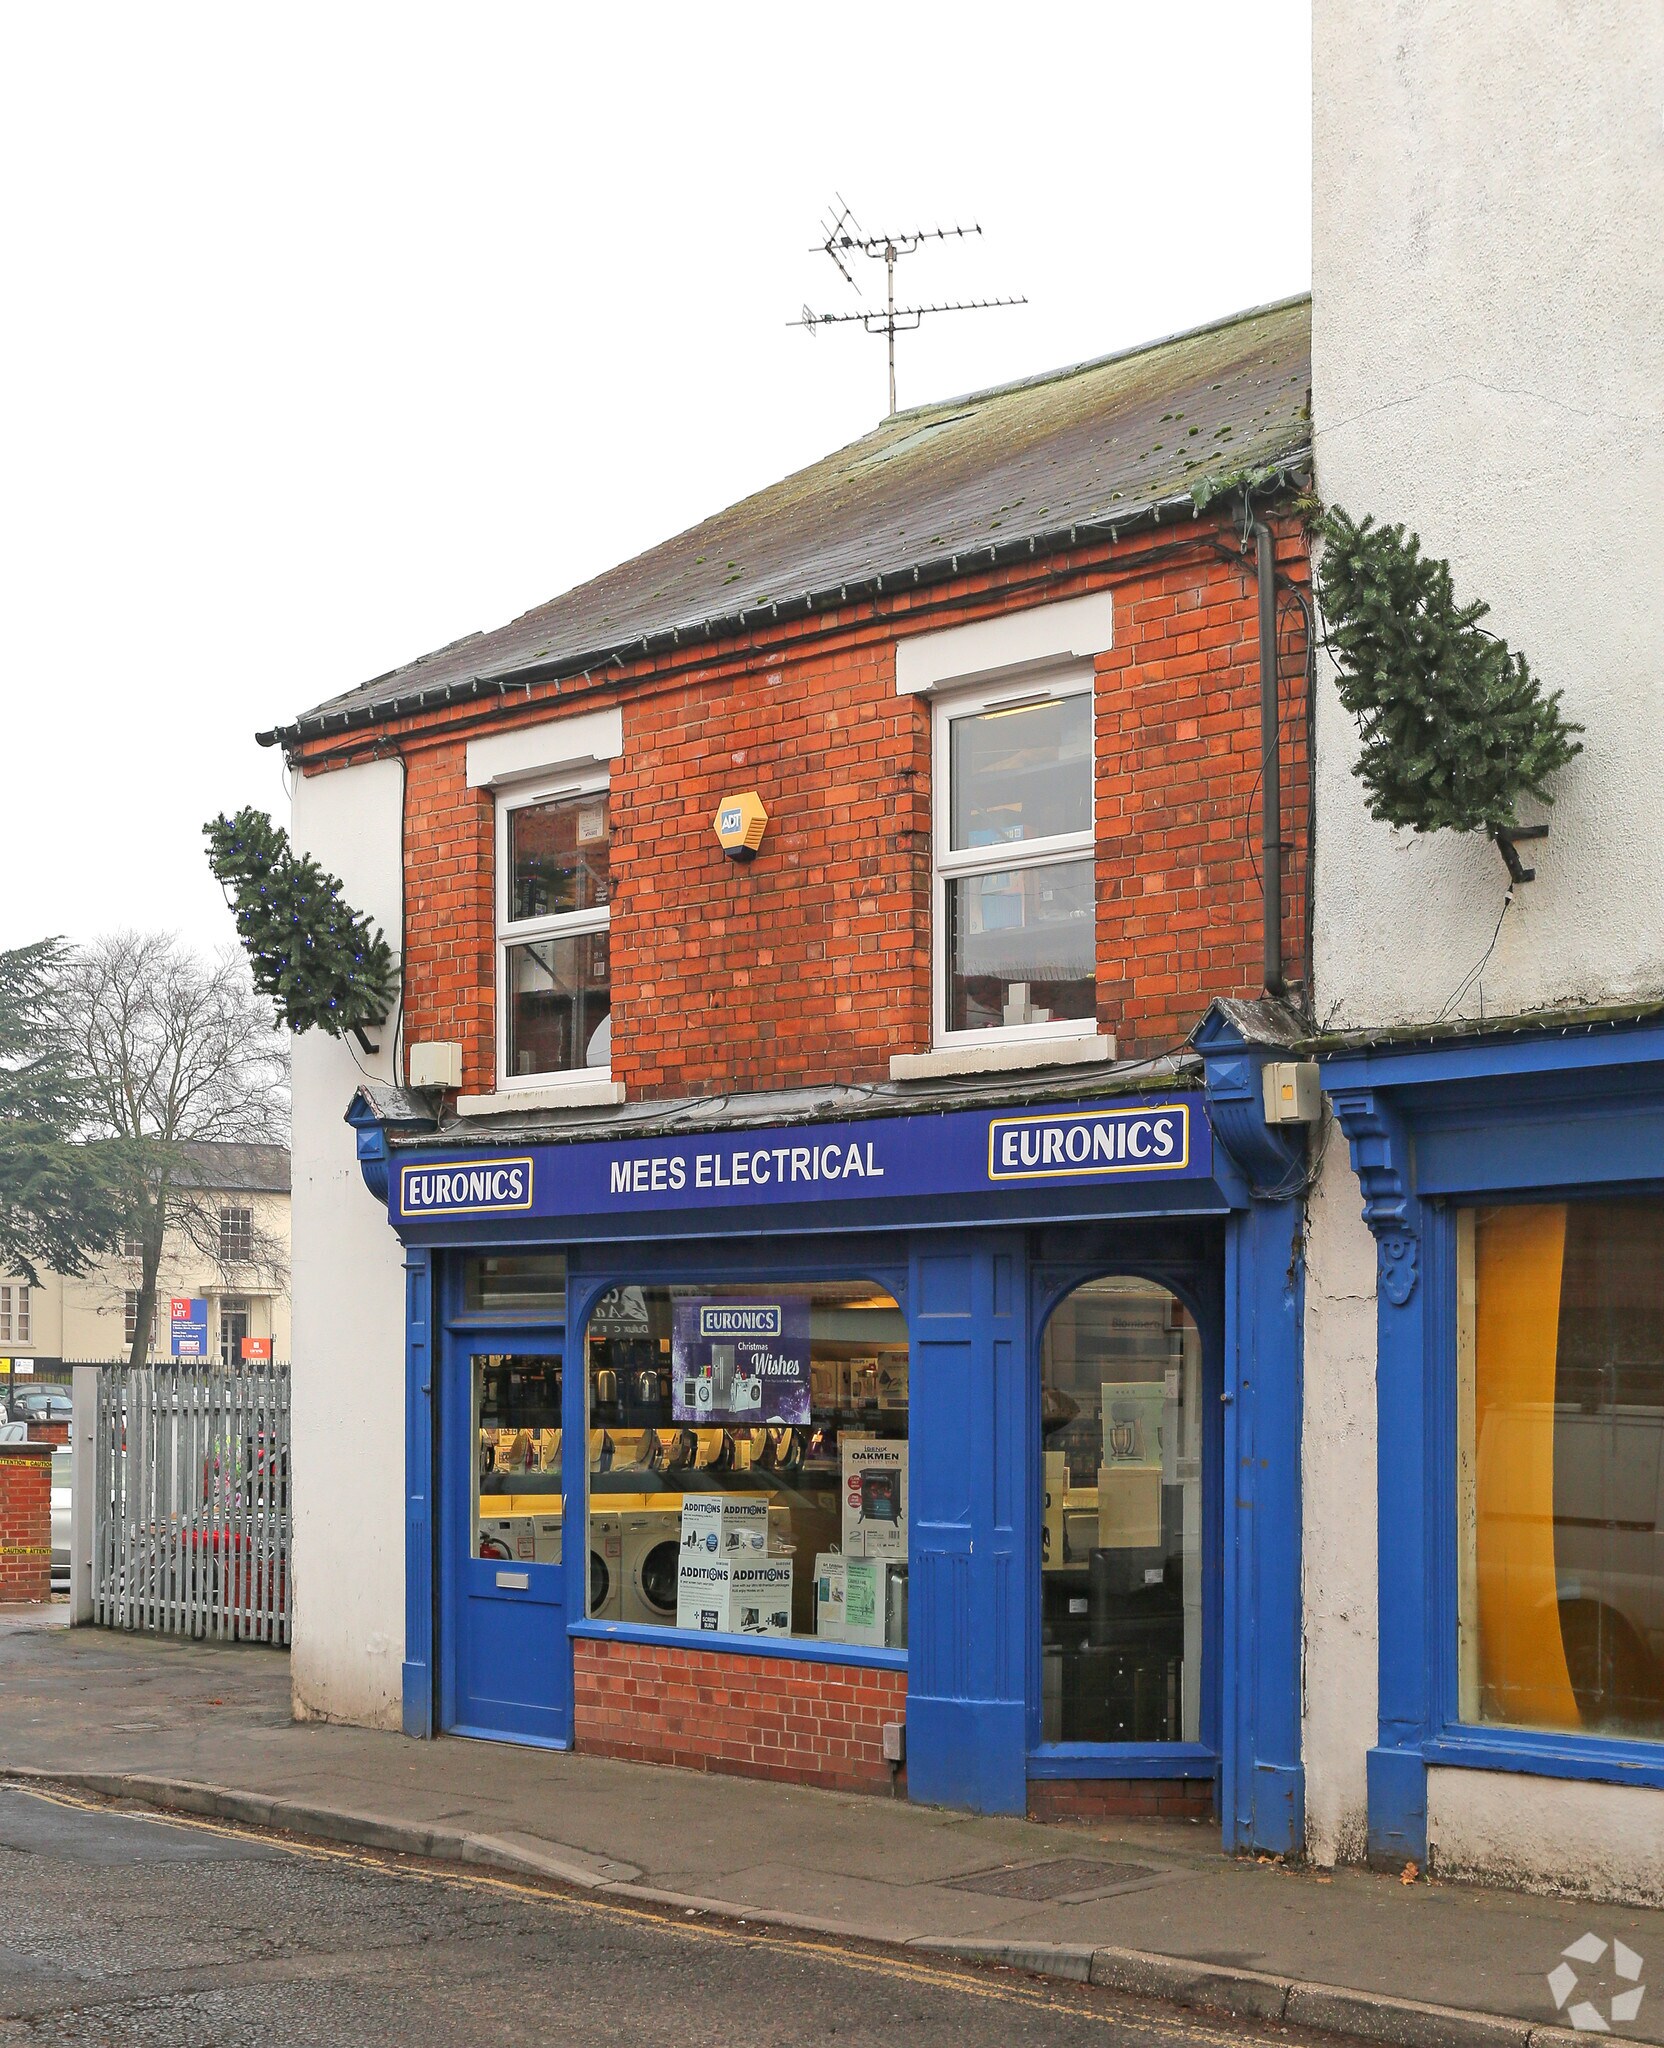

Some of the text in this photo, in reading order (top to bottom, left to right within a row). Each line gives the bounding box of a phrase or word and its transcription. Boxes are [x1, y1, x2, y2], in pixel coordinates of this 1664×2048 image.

[721, 813, 741, 829] ADT
[1002, 1118, 1174, 1166] EURONICS
[610, 1142, 884, 1193] MEES ELECTRICAL
[409, 1168, 523, 1204] EURONICS
[173, 1302, 183, 1310] TO
[706, 1312, 774, 1329] EURONICS
[737, 1342, 768, 1351] Christmas
[751, 1353, 800, 1376] Wishes
[684, 1503, 720, 1513] ADDITIONS
[724, 1505, 767, 1515] ADDITIONS
[849, 1531, 861, 1540] 2
[680, 1567, 728, 1580] ADDITIONS
[733, 1568, 790, 1581] ADDITIONS
